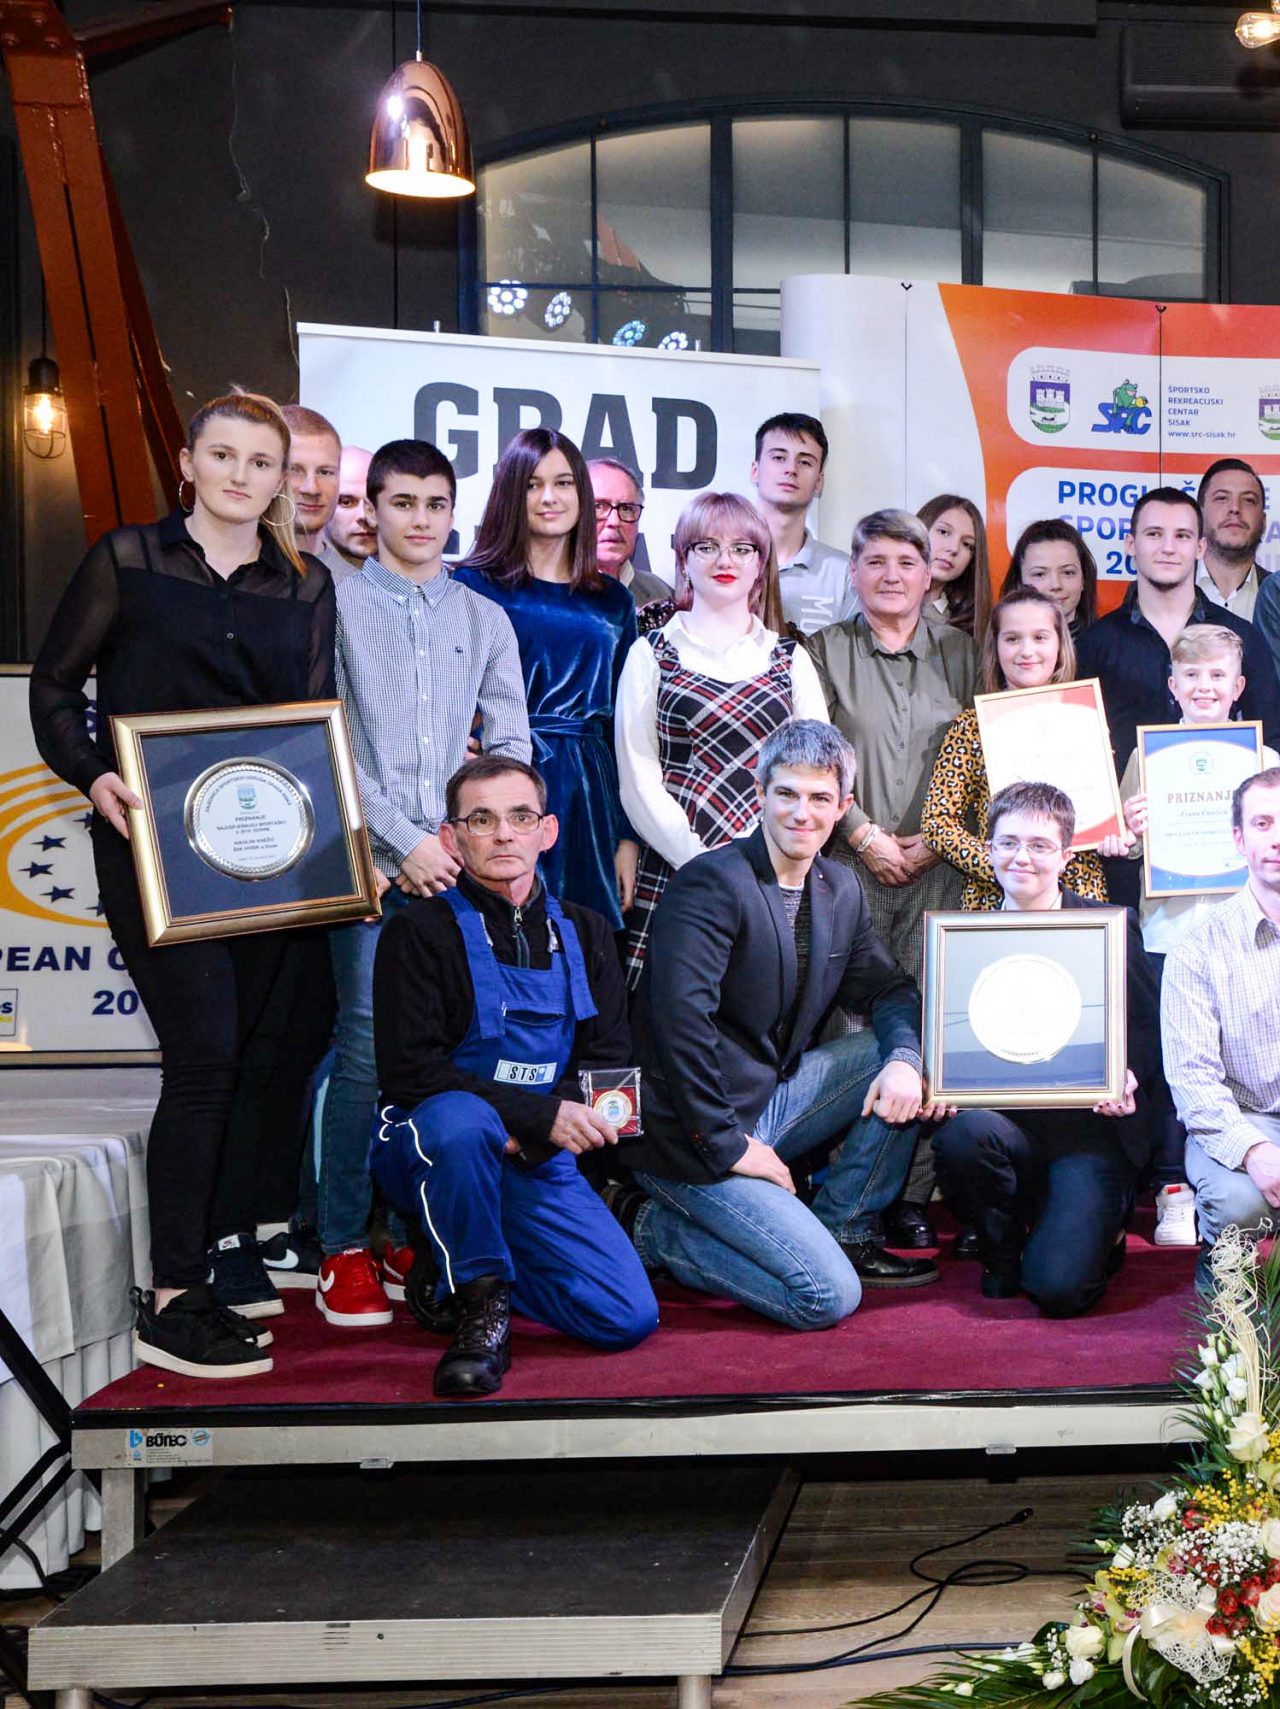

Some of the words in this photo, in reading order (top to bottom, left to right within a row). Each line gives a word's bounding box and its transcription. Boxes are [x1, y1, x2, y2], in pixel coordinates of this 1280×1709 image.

[1167, 385, 1210, 394] ŠPORTSKO
[1167, 397, 1224, 406] REKREACIJSKI
[1167, 408, 1199, 416] CENTAR
[1167, 419, 1191, 427] SISAK
[413, 381, 718, 490] GRAD
[1167, 431, 1236, 439] www.src-sisak.hr
[1167, 790, 1231, 804] PRIZNANJ
[0, 946, 91, 972] EAN
[92, 990, 139, 1015] 20
[510, 1066, 537, 1081] STS
